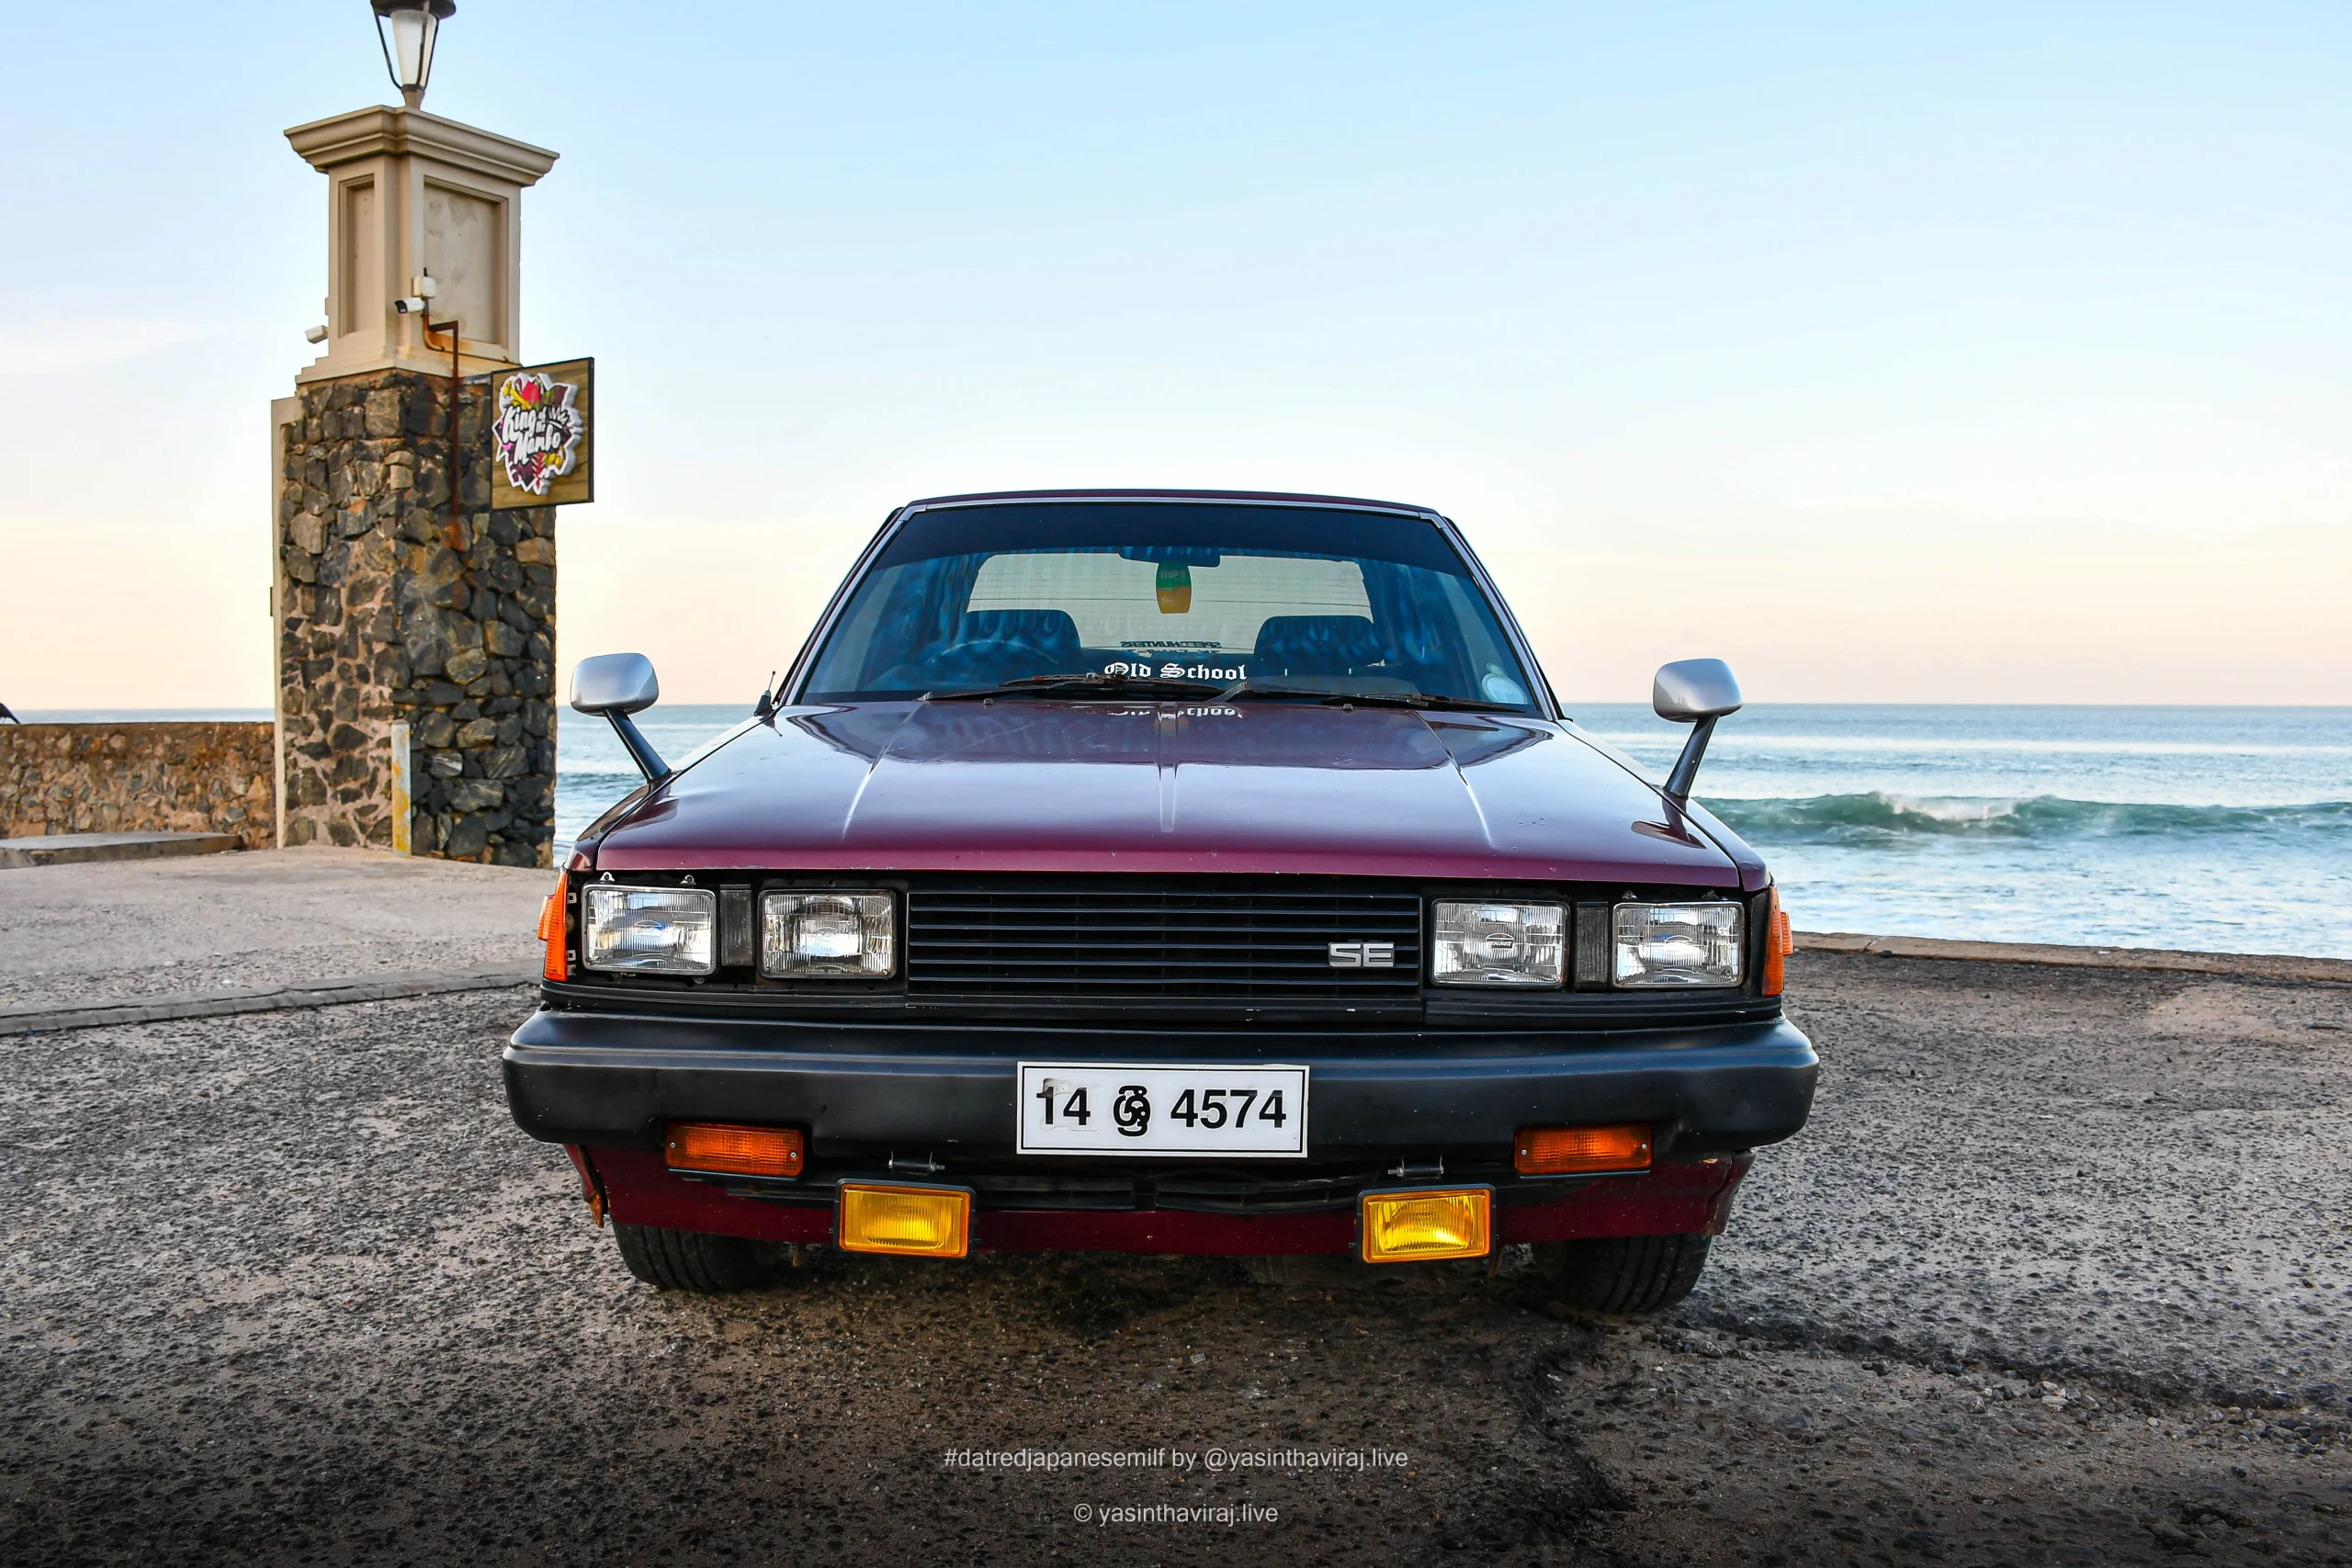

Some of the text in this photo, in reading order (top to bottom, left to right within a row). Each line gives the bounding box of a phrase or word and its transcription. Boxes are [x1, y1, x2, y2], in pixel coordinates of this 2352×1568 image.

[502, 405, 537, 444] King
[1103, 661, 1248, 681] Old School
[1329, 942, 1395, 967] SE
[1035, 1085, 1091, 1126] 14
[1170, 1089, 1287, 1130] 4574
